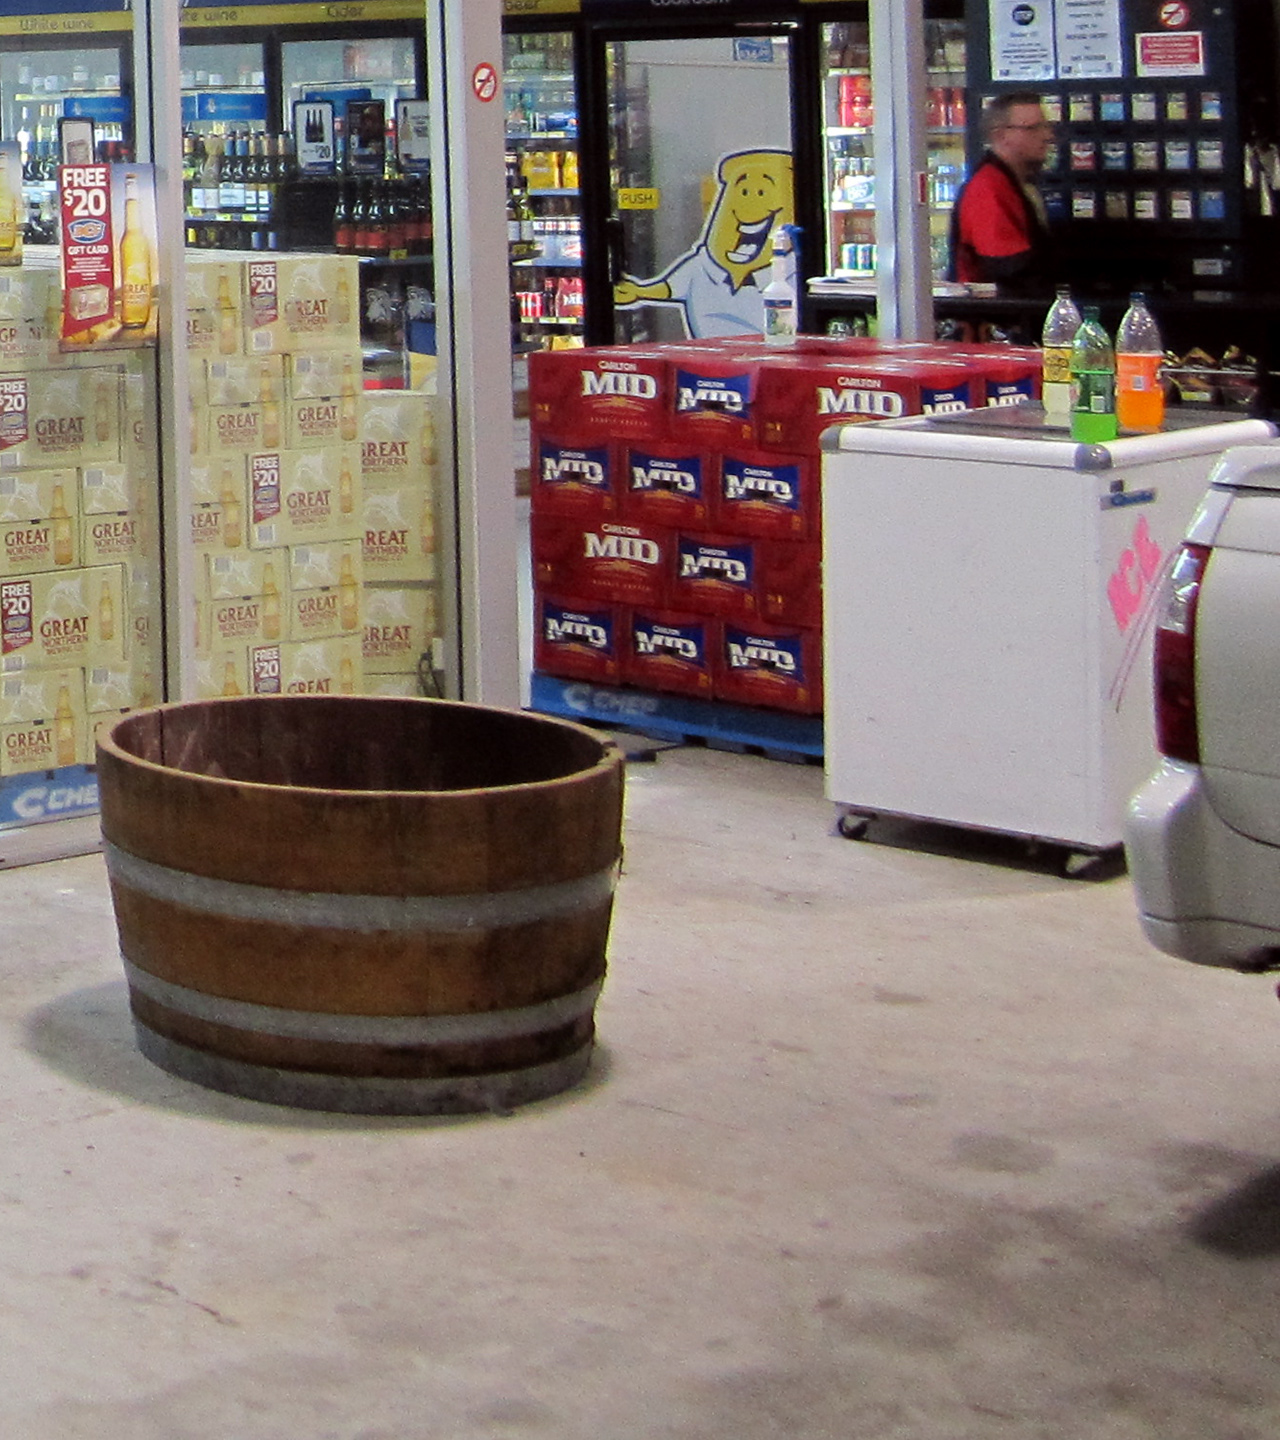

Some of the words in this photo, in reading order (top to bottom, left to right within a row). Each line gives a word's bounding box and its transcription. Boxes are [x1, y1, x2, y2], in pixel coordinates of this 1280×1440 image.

[203, 9, 238, 22] wine
[63, 19, 95, 30] wine
[62, 167, 106, 188] FREE
[63, 188, 107, 217] $20
[620, 193, 653, 206] PUSH
[67, 245, 85, 255] GIFT
[86, 244, 109, 255] CARD
[250, 264, 276, 276] FREE
[251, 277, 276, 293] $20
[598, 360, 638, 371] CARLTON
[580, 370, 657, 399] MID
[837, 377, 881, 388] CARLTON
[679, 387, 743, 412] MID
[817, 386, 903, 417] MID
[217, 413, 260, 430] GREAT
[297, 405, 339, 422] GREAT
[35, 416, 85, 436] GREAT
[37, 434, 85, 445] NORTHERN
[253, 457, 278, 469] FREE
[543, 456, 604, 485] MID
[253, 470, 279, 486] $20
[632, 466, 696, 493] MID
[726, 474, 793, 500] MID
[287, 490, 332, 507] GREAT
[4, 528, 51, 546] GREAT
[92, 520, 137, 539] GREAT
[601, 523, 640, 535] CARLTON
[6, 545, 50, 557] NORTHERN
[93, 538, 137, 550] NORTHERN
[584, 532, 660, 565] MID
[681, 552, 747, 582] MID
[2, 584, 30, 597] FREE
[2, 598, 30, 615] $20
[297, 595, 339, 612] GREAT
[217, 604, 260, 621] GREAT
[40, 616, 90, 637] GREAT
[546, 617, 607, 648] MID
[42, 636, 89, 648] NORTHERN
[636, 631, 697, 659] MID
[254, 649, 279, 659] FREE
[729, 642, 795, 671] MID
[255, 662, 279, 678] $20
[6, 729, 52, 749] GREAT
[8, 746, 52, 758] NORTHERN
